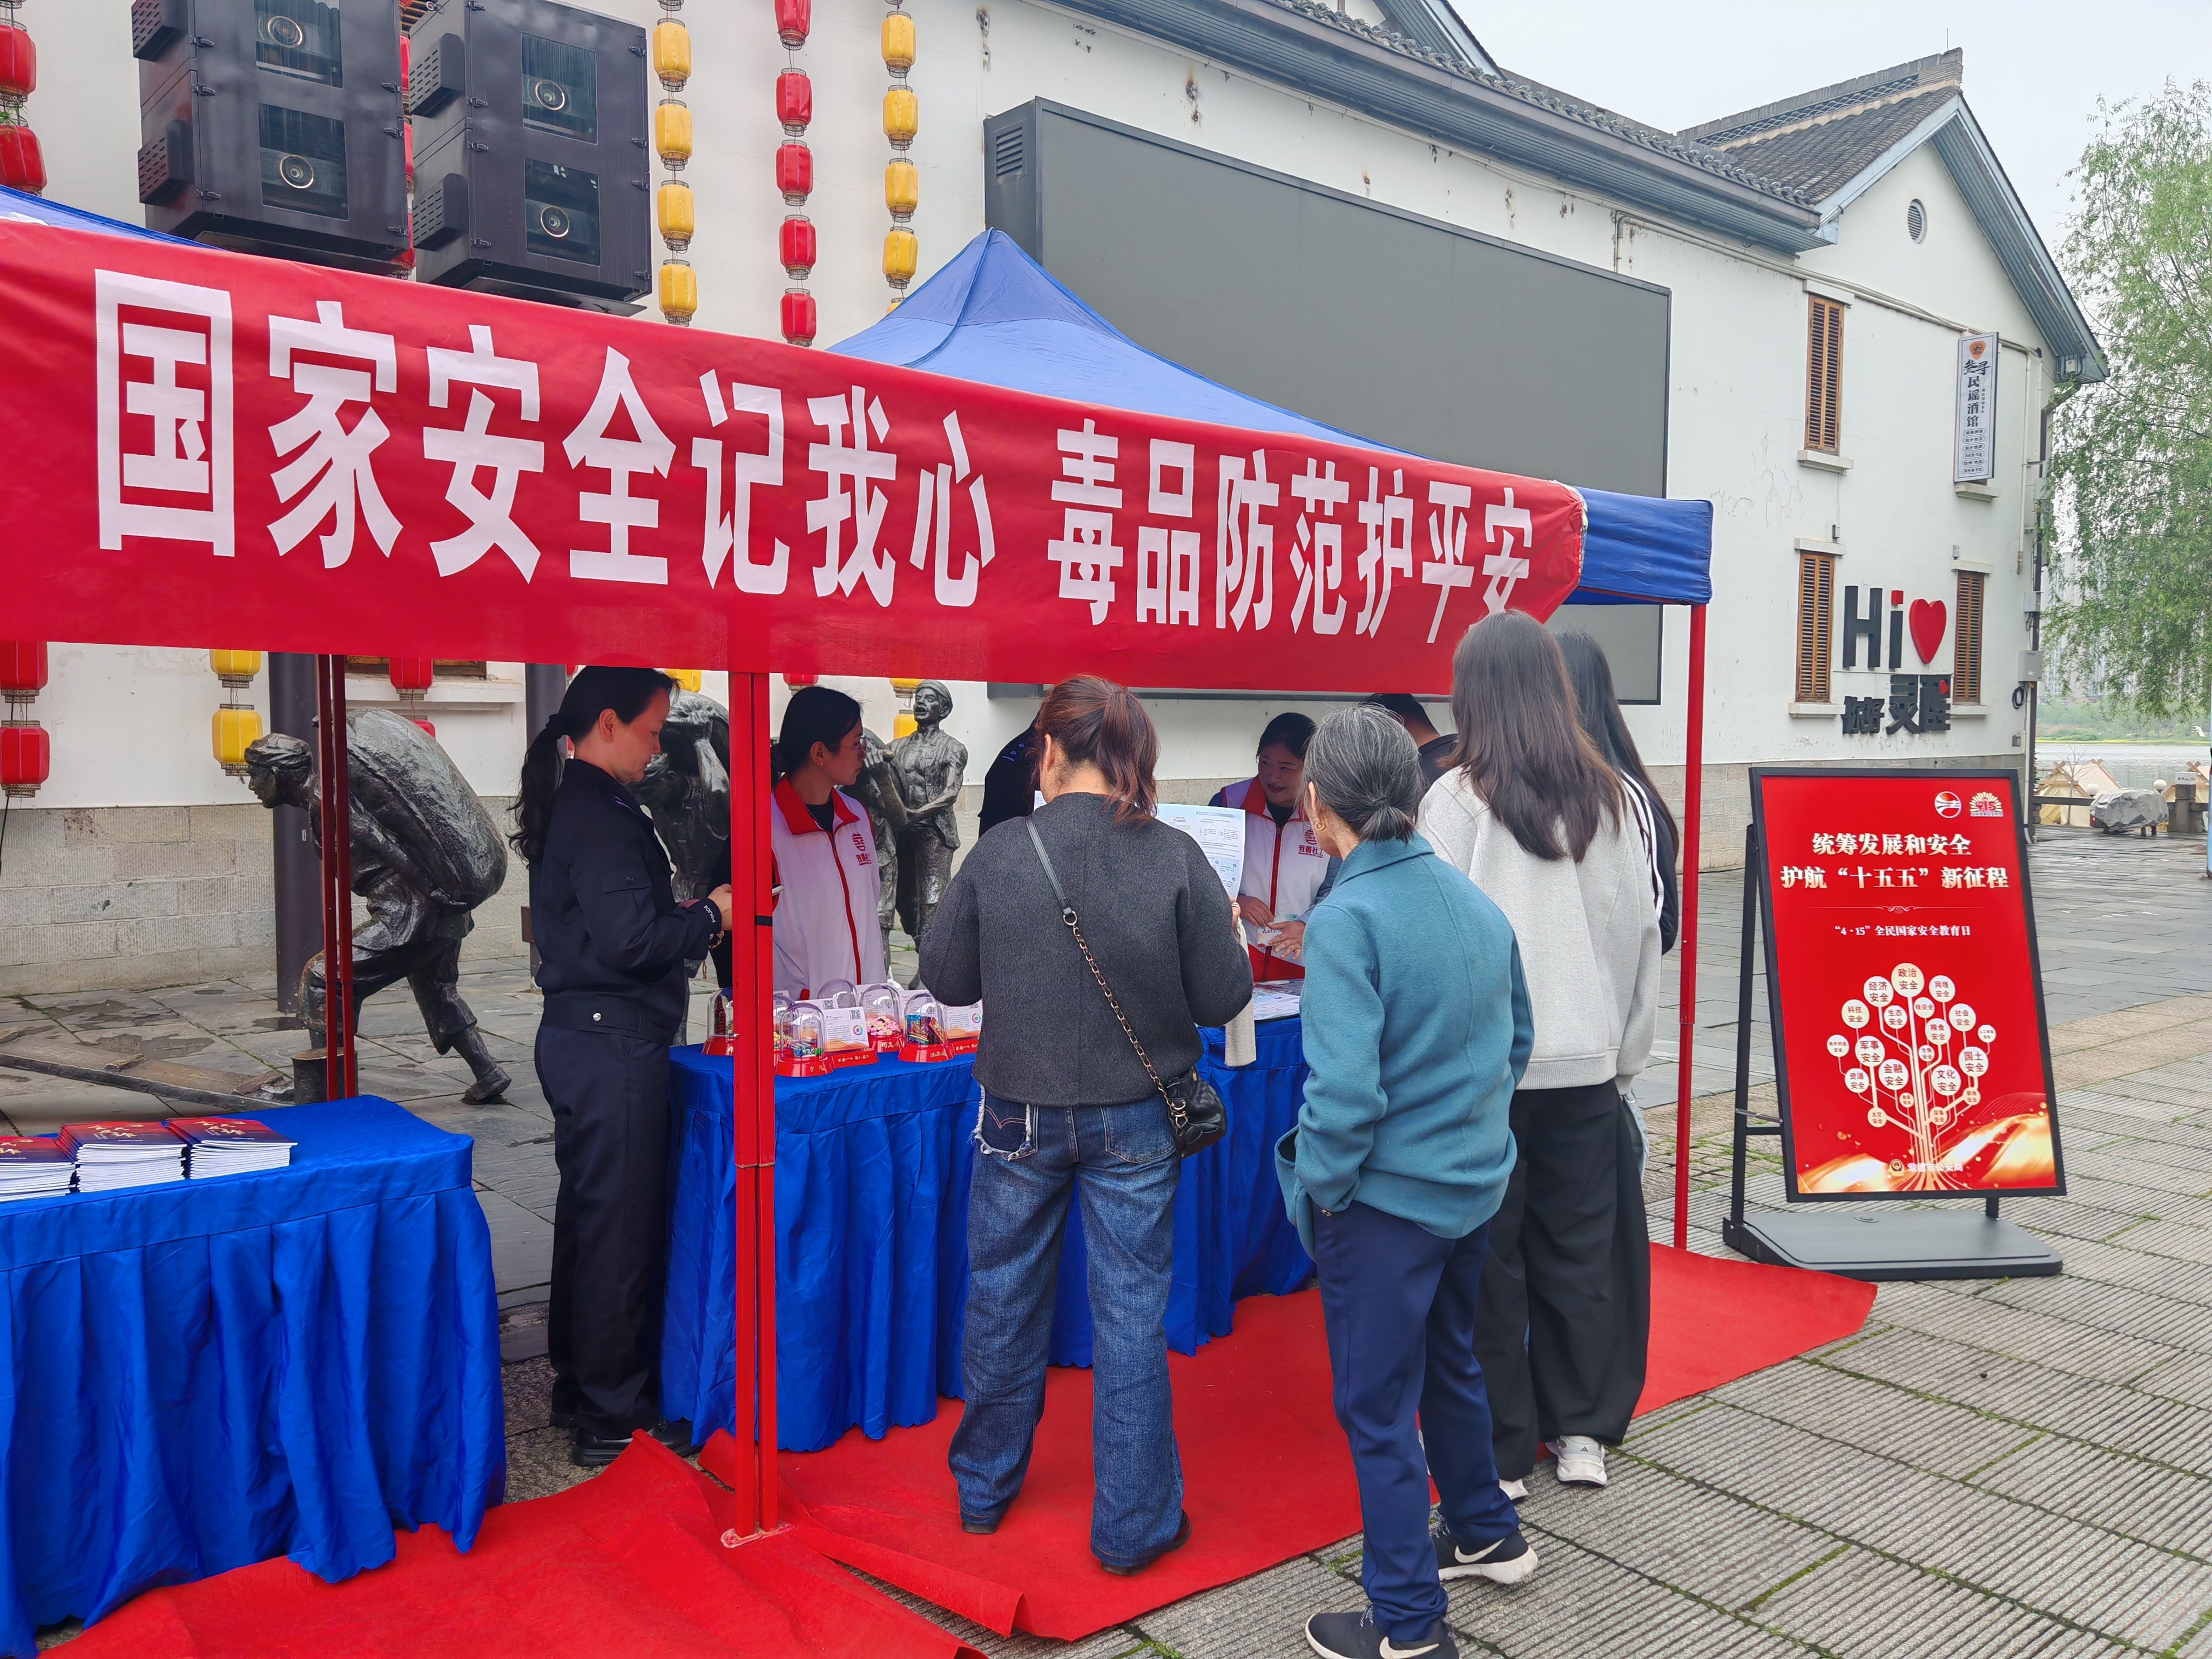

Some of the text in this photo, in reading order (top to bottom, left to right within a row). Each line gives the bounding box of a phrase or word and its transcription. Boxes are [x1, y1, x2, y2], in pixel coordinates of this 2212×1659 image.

[1967, 376, 1980, 427] 民谣酒馆
[95, 268, 1532, 643] 国家安全记我心 毒品防范护平安
[1843, 585, 1904, 669] Hi
[1812, 833, 1972, 857] 统筹发展和安全
[703, 905, 716, 923] POLICE
[1897, 968, 1917, 977] 政治
[1869, 981, 1887, 991] 经济
[1899, 981, 1918, 990] 安全
[1870, 993, 1889, 1002] 安全
[1859, 1040, 1879, 1050] 军事
[1861, 1053, 1880, 1062] 安全
[1964, 1051, 1983, 1061] 国土
[1884, 1064, 1903, 1073] 金融
[1965, 1063, 1984, 1072] 安全
[1937, 1069, 1955, 1079] 文化
[1885, 1076, 1904, 1086] 安全
[1938, 1082, 1957, 1091] 安全
